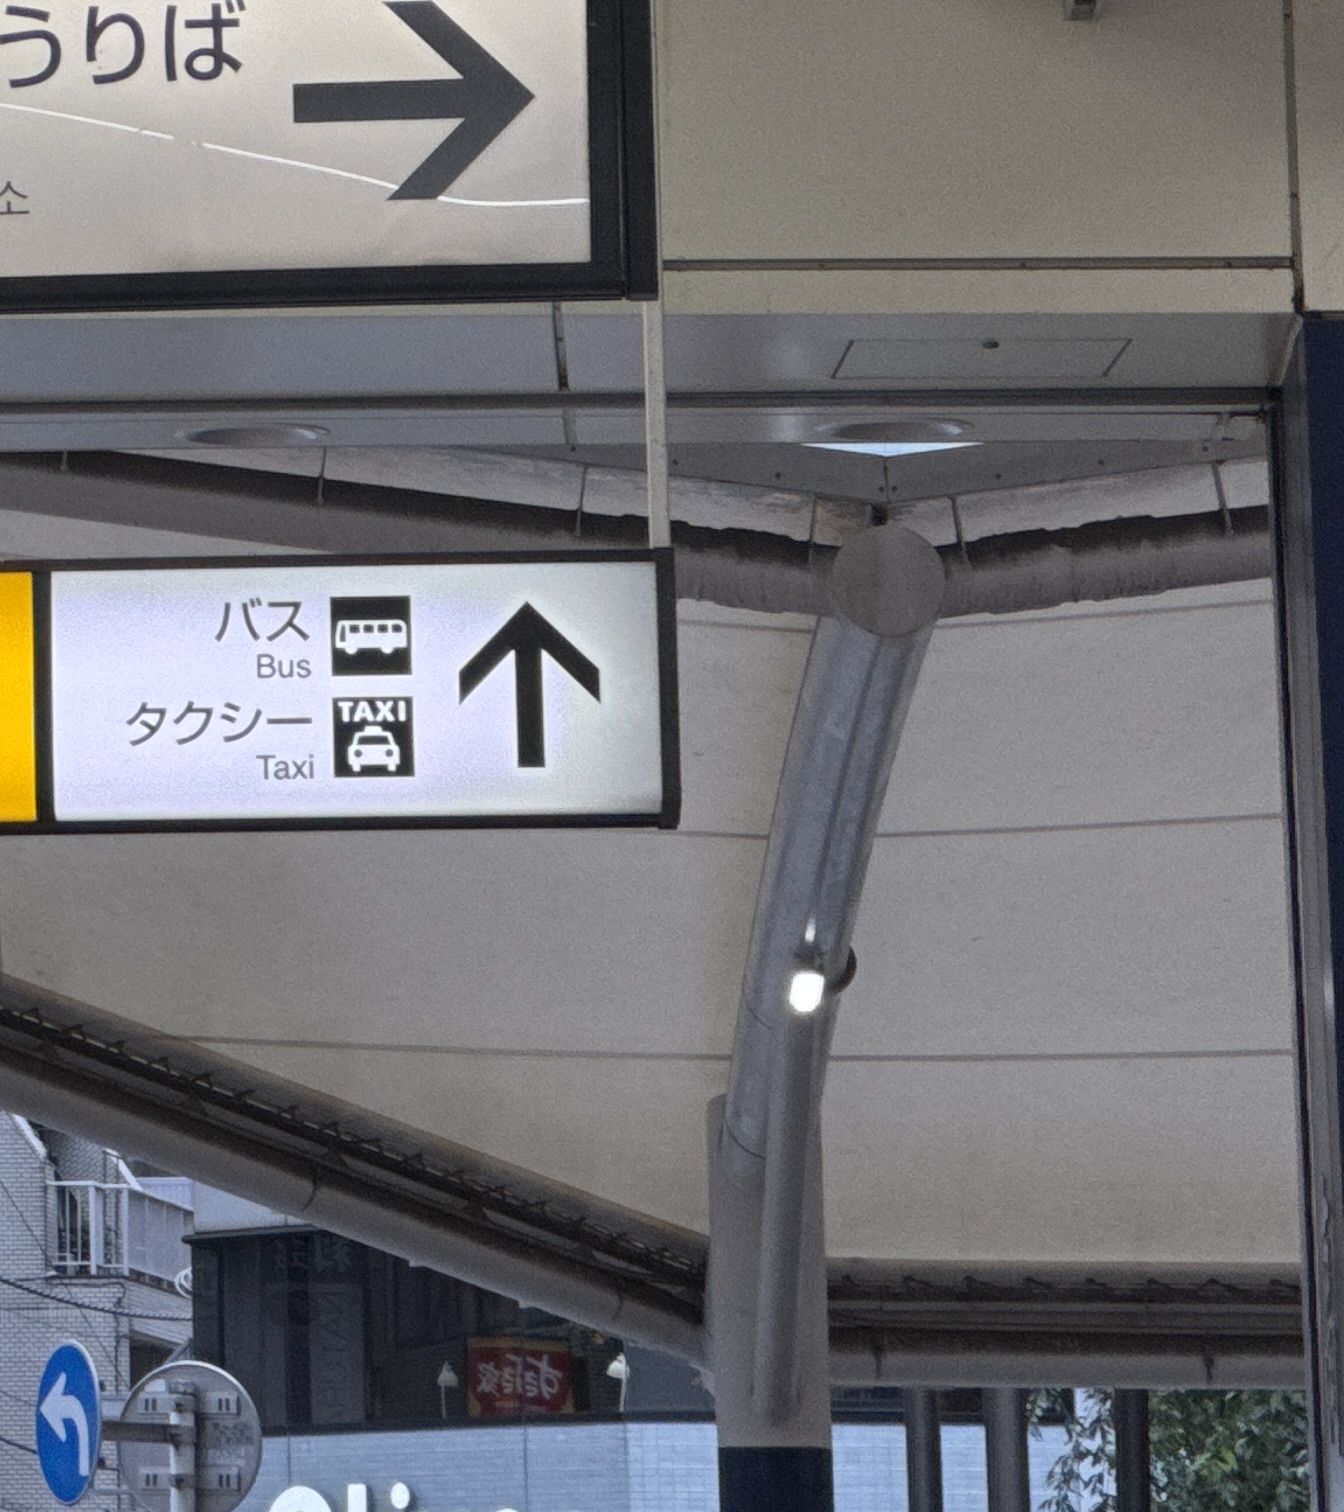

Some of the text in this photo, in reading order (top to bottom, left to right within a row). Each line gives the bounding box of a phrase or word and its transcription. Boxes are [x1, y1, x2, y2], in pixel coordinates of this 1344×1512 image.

[216, 598, 309, 641] バス
[257, 654, 311, 679] Bus
[127, 701, 312, 746] タクシー
[338, 700, 407, 722] TAXI
[256, 755, 314, 780] Taxi
